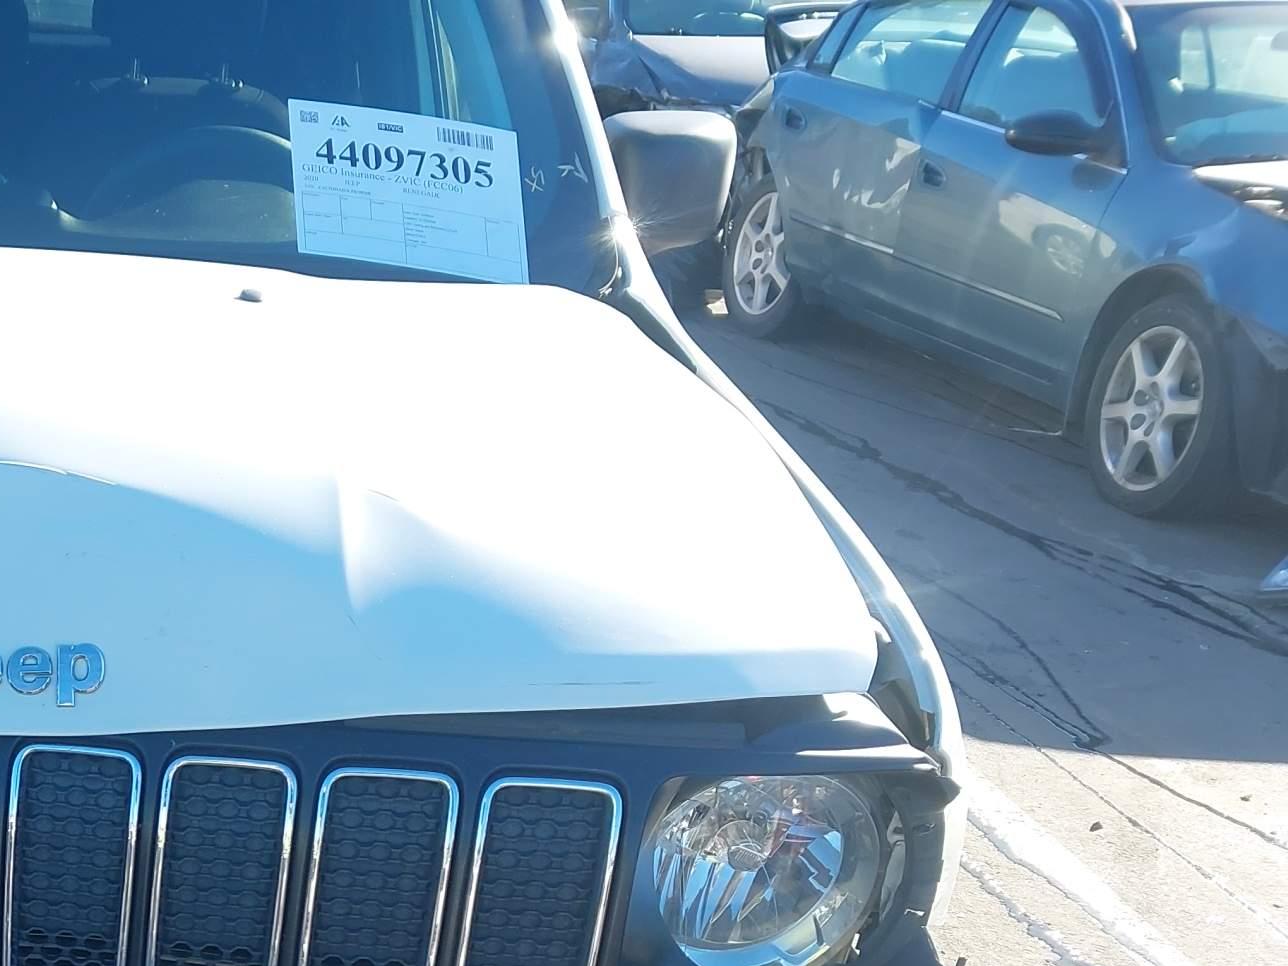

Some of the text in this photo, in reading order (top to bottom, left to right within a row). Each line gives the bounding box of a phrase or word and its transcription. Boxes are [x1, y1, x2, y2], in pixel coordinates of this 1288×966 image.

[302, 163, 338, 174] GEICO
[341, 167, 385, 182] Insurance
[316, 138, 493, 188] 44097305
